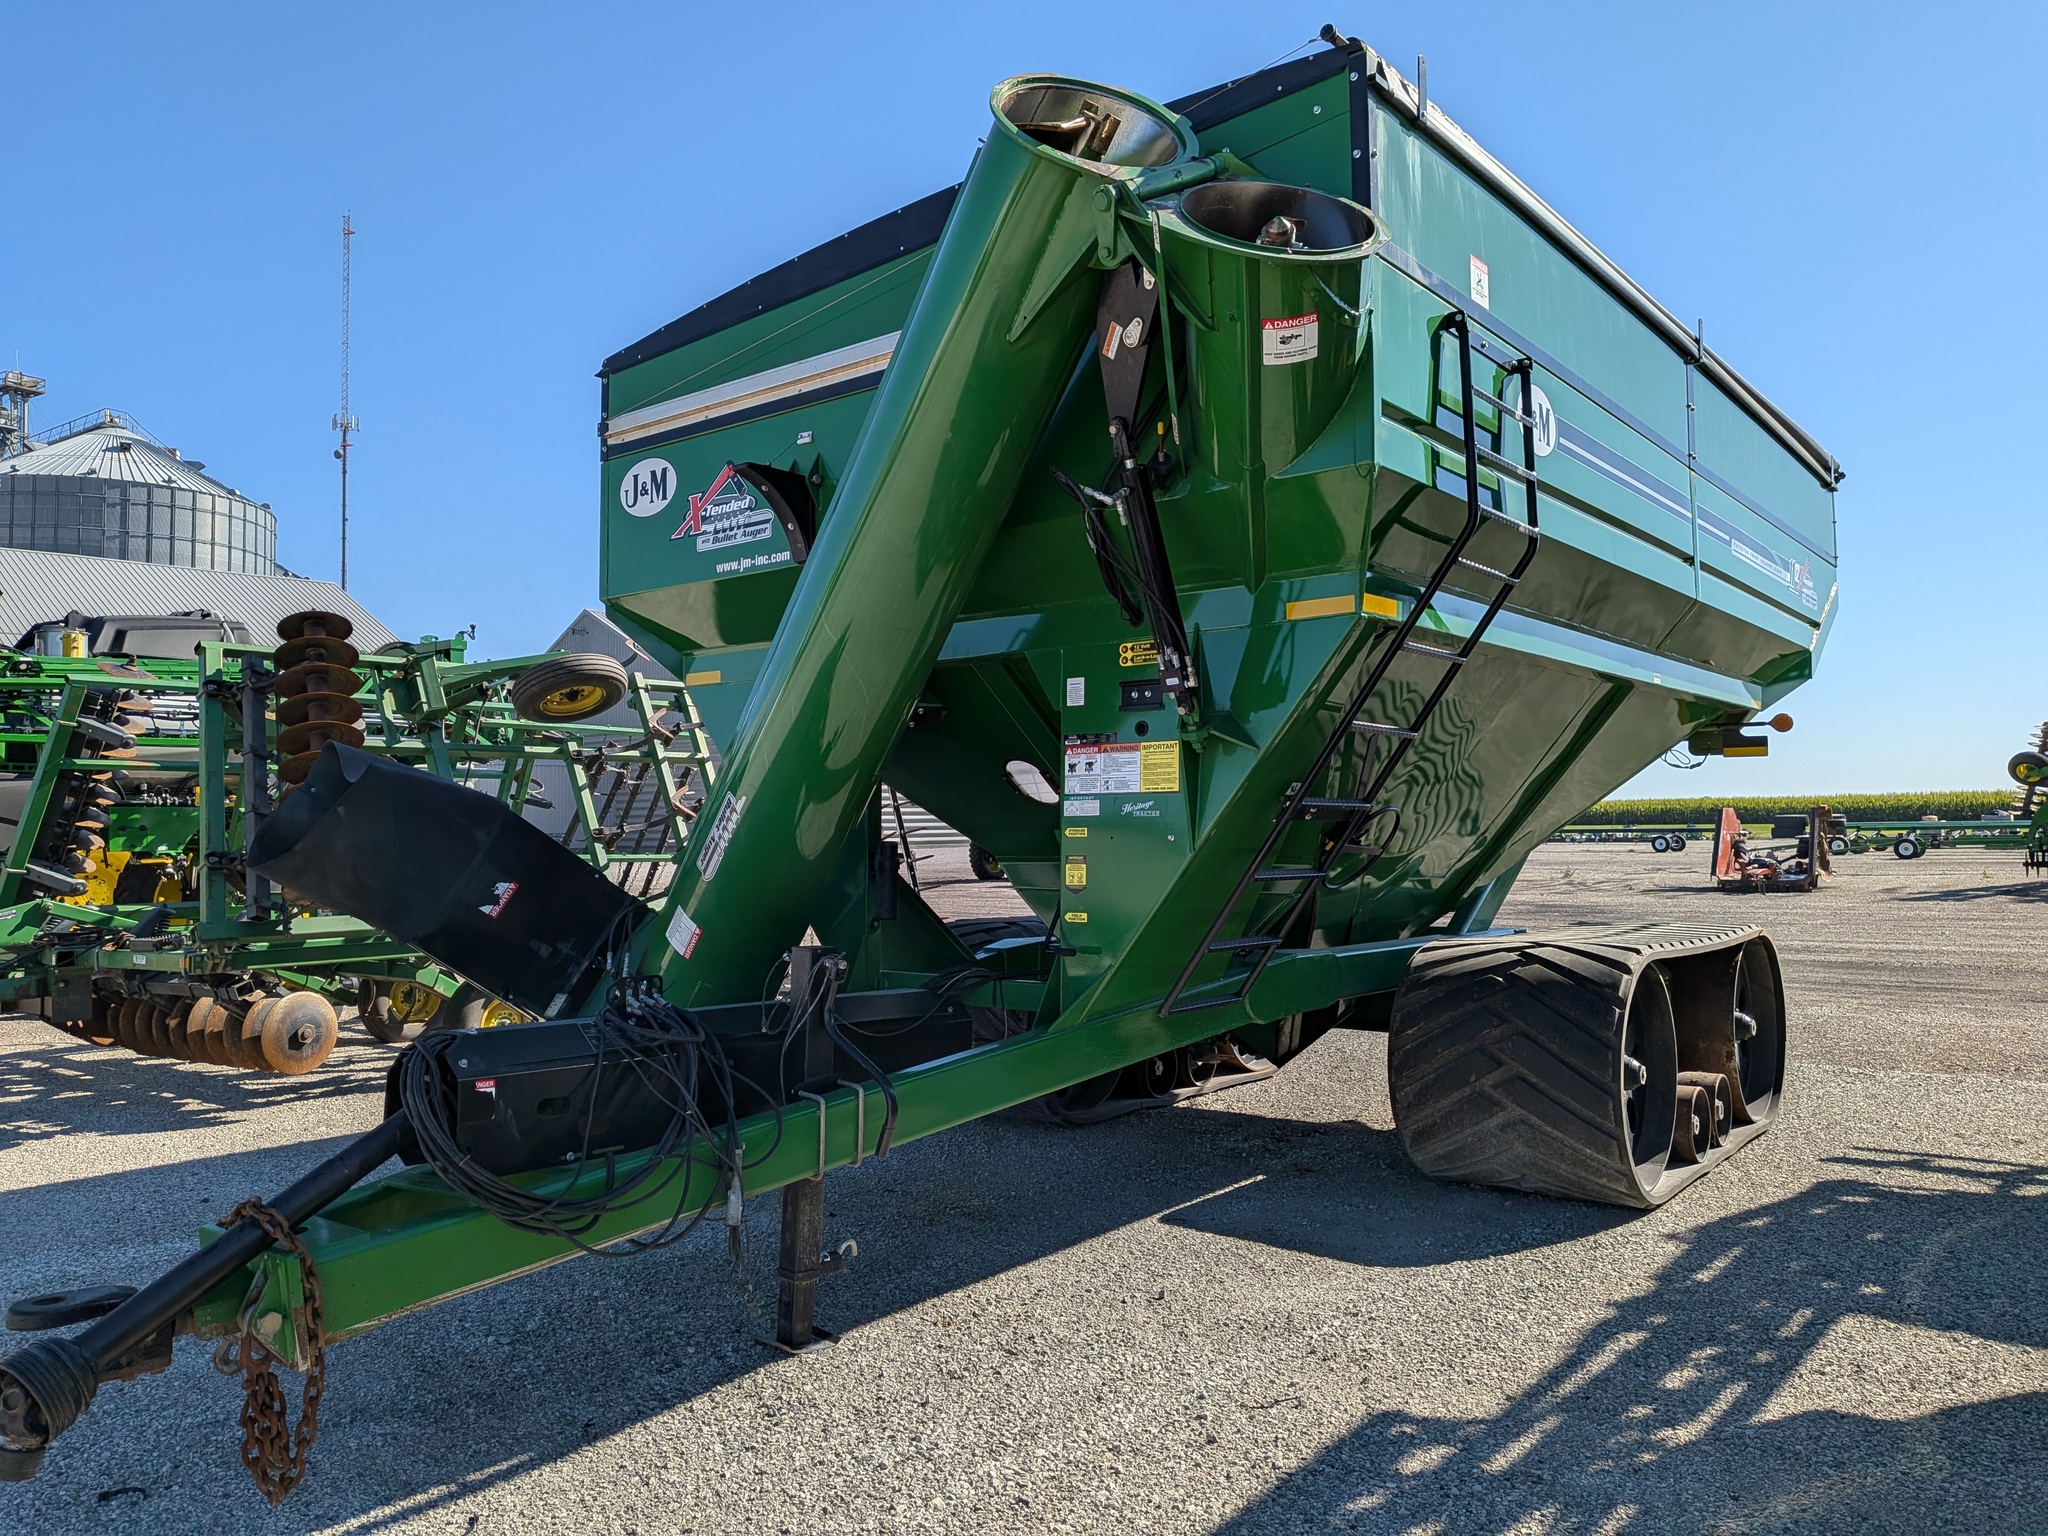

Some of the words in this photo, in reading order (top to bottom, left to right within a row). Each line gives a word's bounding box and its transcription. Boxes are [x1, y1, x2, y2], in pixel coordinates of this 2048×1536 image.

[1274, 314, 1317, 329] DANGER
[624, 466, 669, 509] J&M
[711, 533, 738, 545] Bullet
[739, 526, 768, 539] Auger
[716, 550, 791, 573] www.jm-inc.com
[1072, 746, 1099, 754] DANGER
[1109, 744, 1139, 753] WARNING
[1142, 742, 1179, 751] IMPORTANT
[715, 796, 732, 833] Bullet
[1120, 800, 1155, 816] Heritage
[489, 888, 513, 917] DANGER
[684, 932, 700, 960] DANGER
